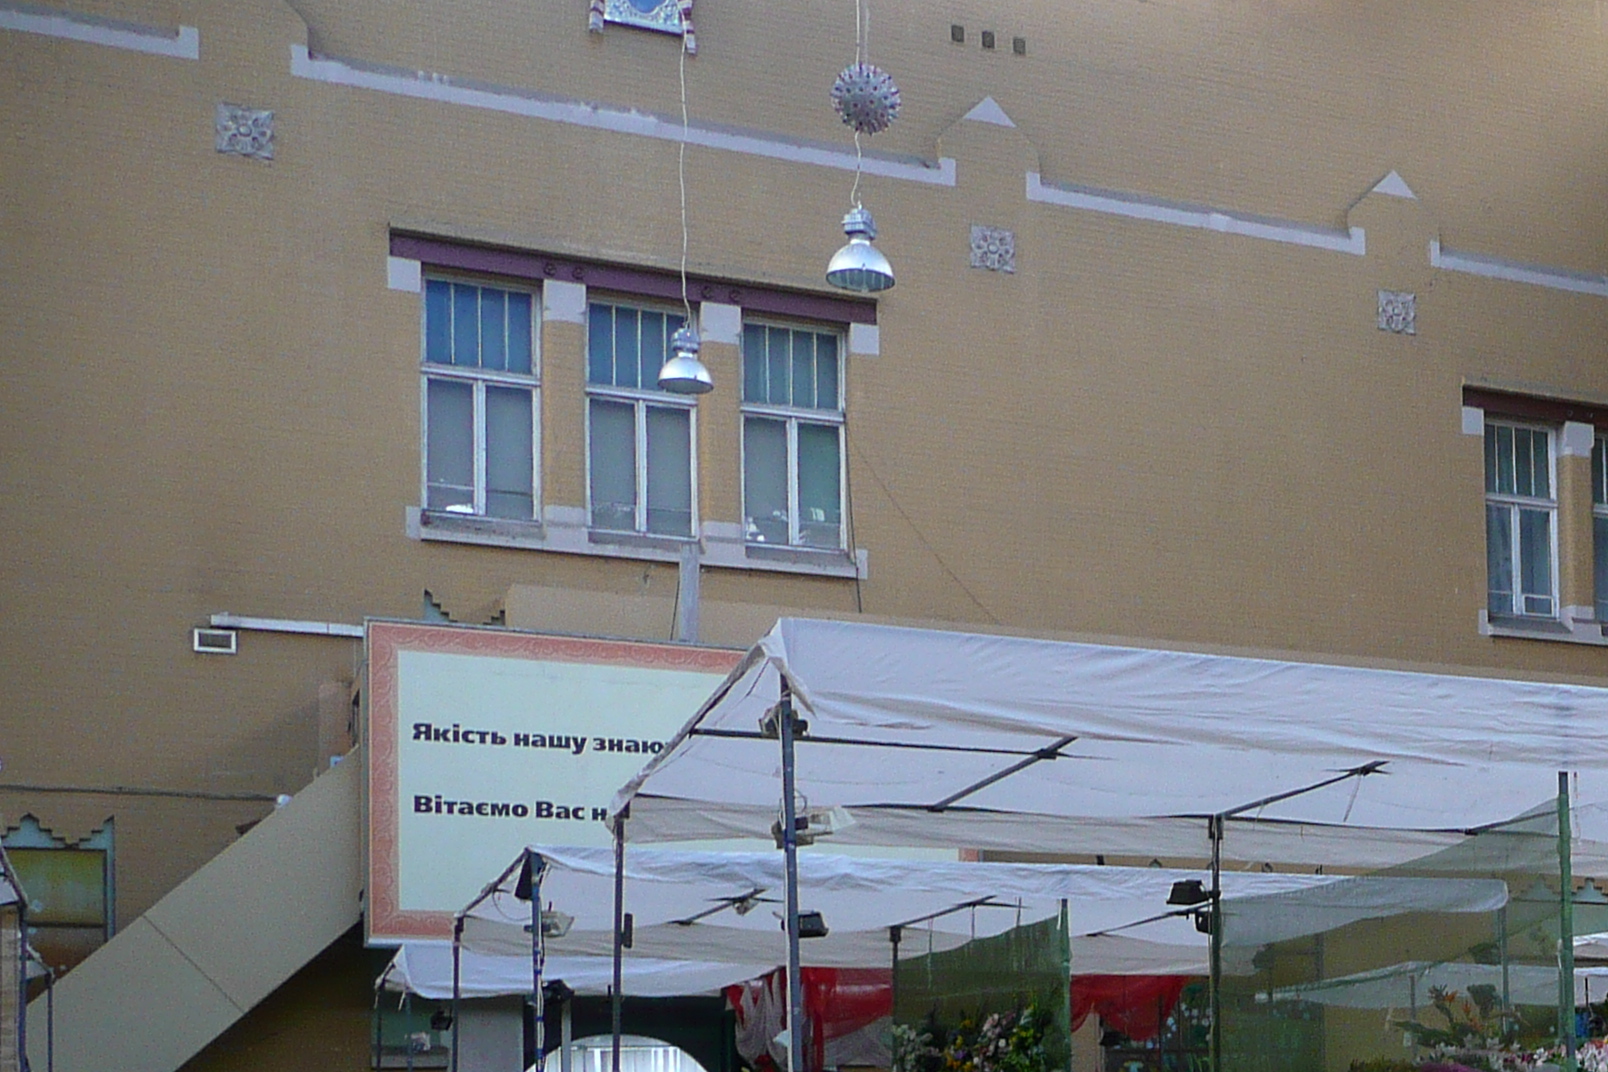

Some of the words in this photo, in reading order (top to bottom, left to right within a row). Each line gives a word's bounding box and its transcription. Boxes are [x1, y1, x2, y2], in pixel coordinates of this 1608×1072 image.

[412, 722, 506, 746] Якість
[513, 732, 587, 755] нашу
[592, 737, 668, 755] знаю
[413, 795, 528, 819] Вітаємо
[535, 801, 584, 821] Вас
[592, 807, 608, 822] н
